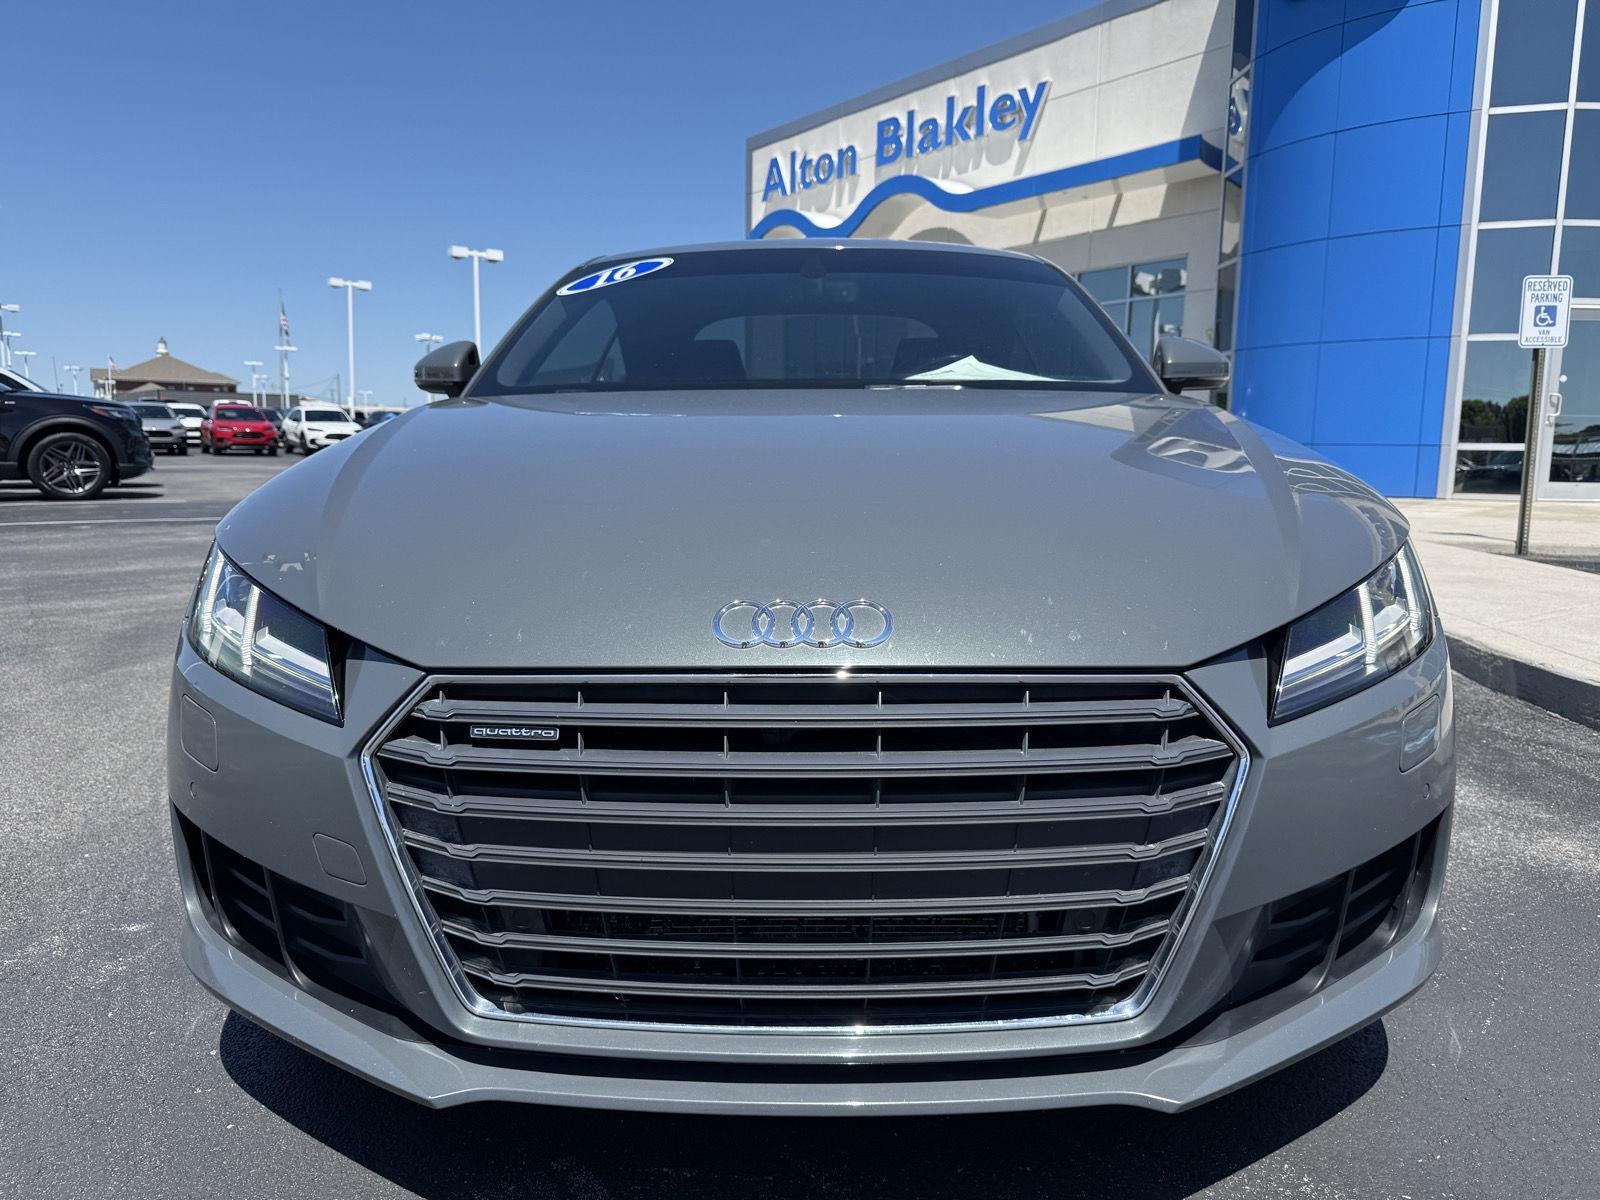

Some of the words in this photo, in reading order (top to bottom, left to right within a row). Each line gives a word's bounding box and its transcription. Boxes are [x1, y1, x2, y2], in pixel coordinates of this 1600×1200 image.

[762, 144, 858, 201] Alton
[876, 80, 1048, 167] Blakley
[594, 266, 637, 287] 16
[1527, 280, 1568, 291] RESERVED
[1531, 293, 1563, 303] PARKING
[1524, 335, 1562, 343] ACCESSIBLE
[474, 728, 554, 737] quattro
